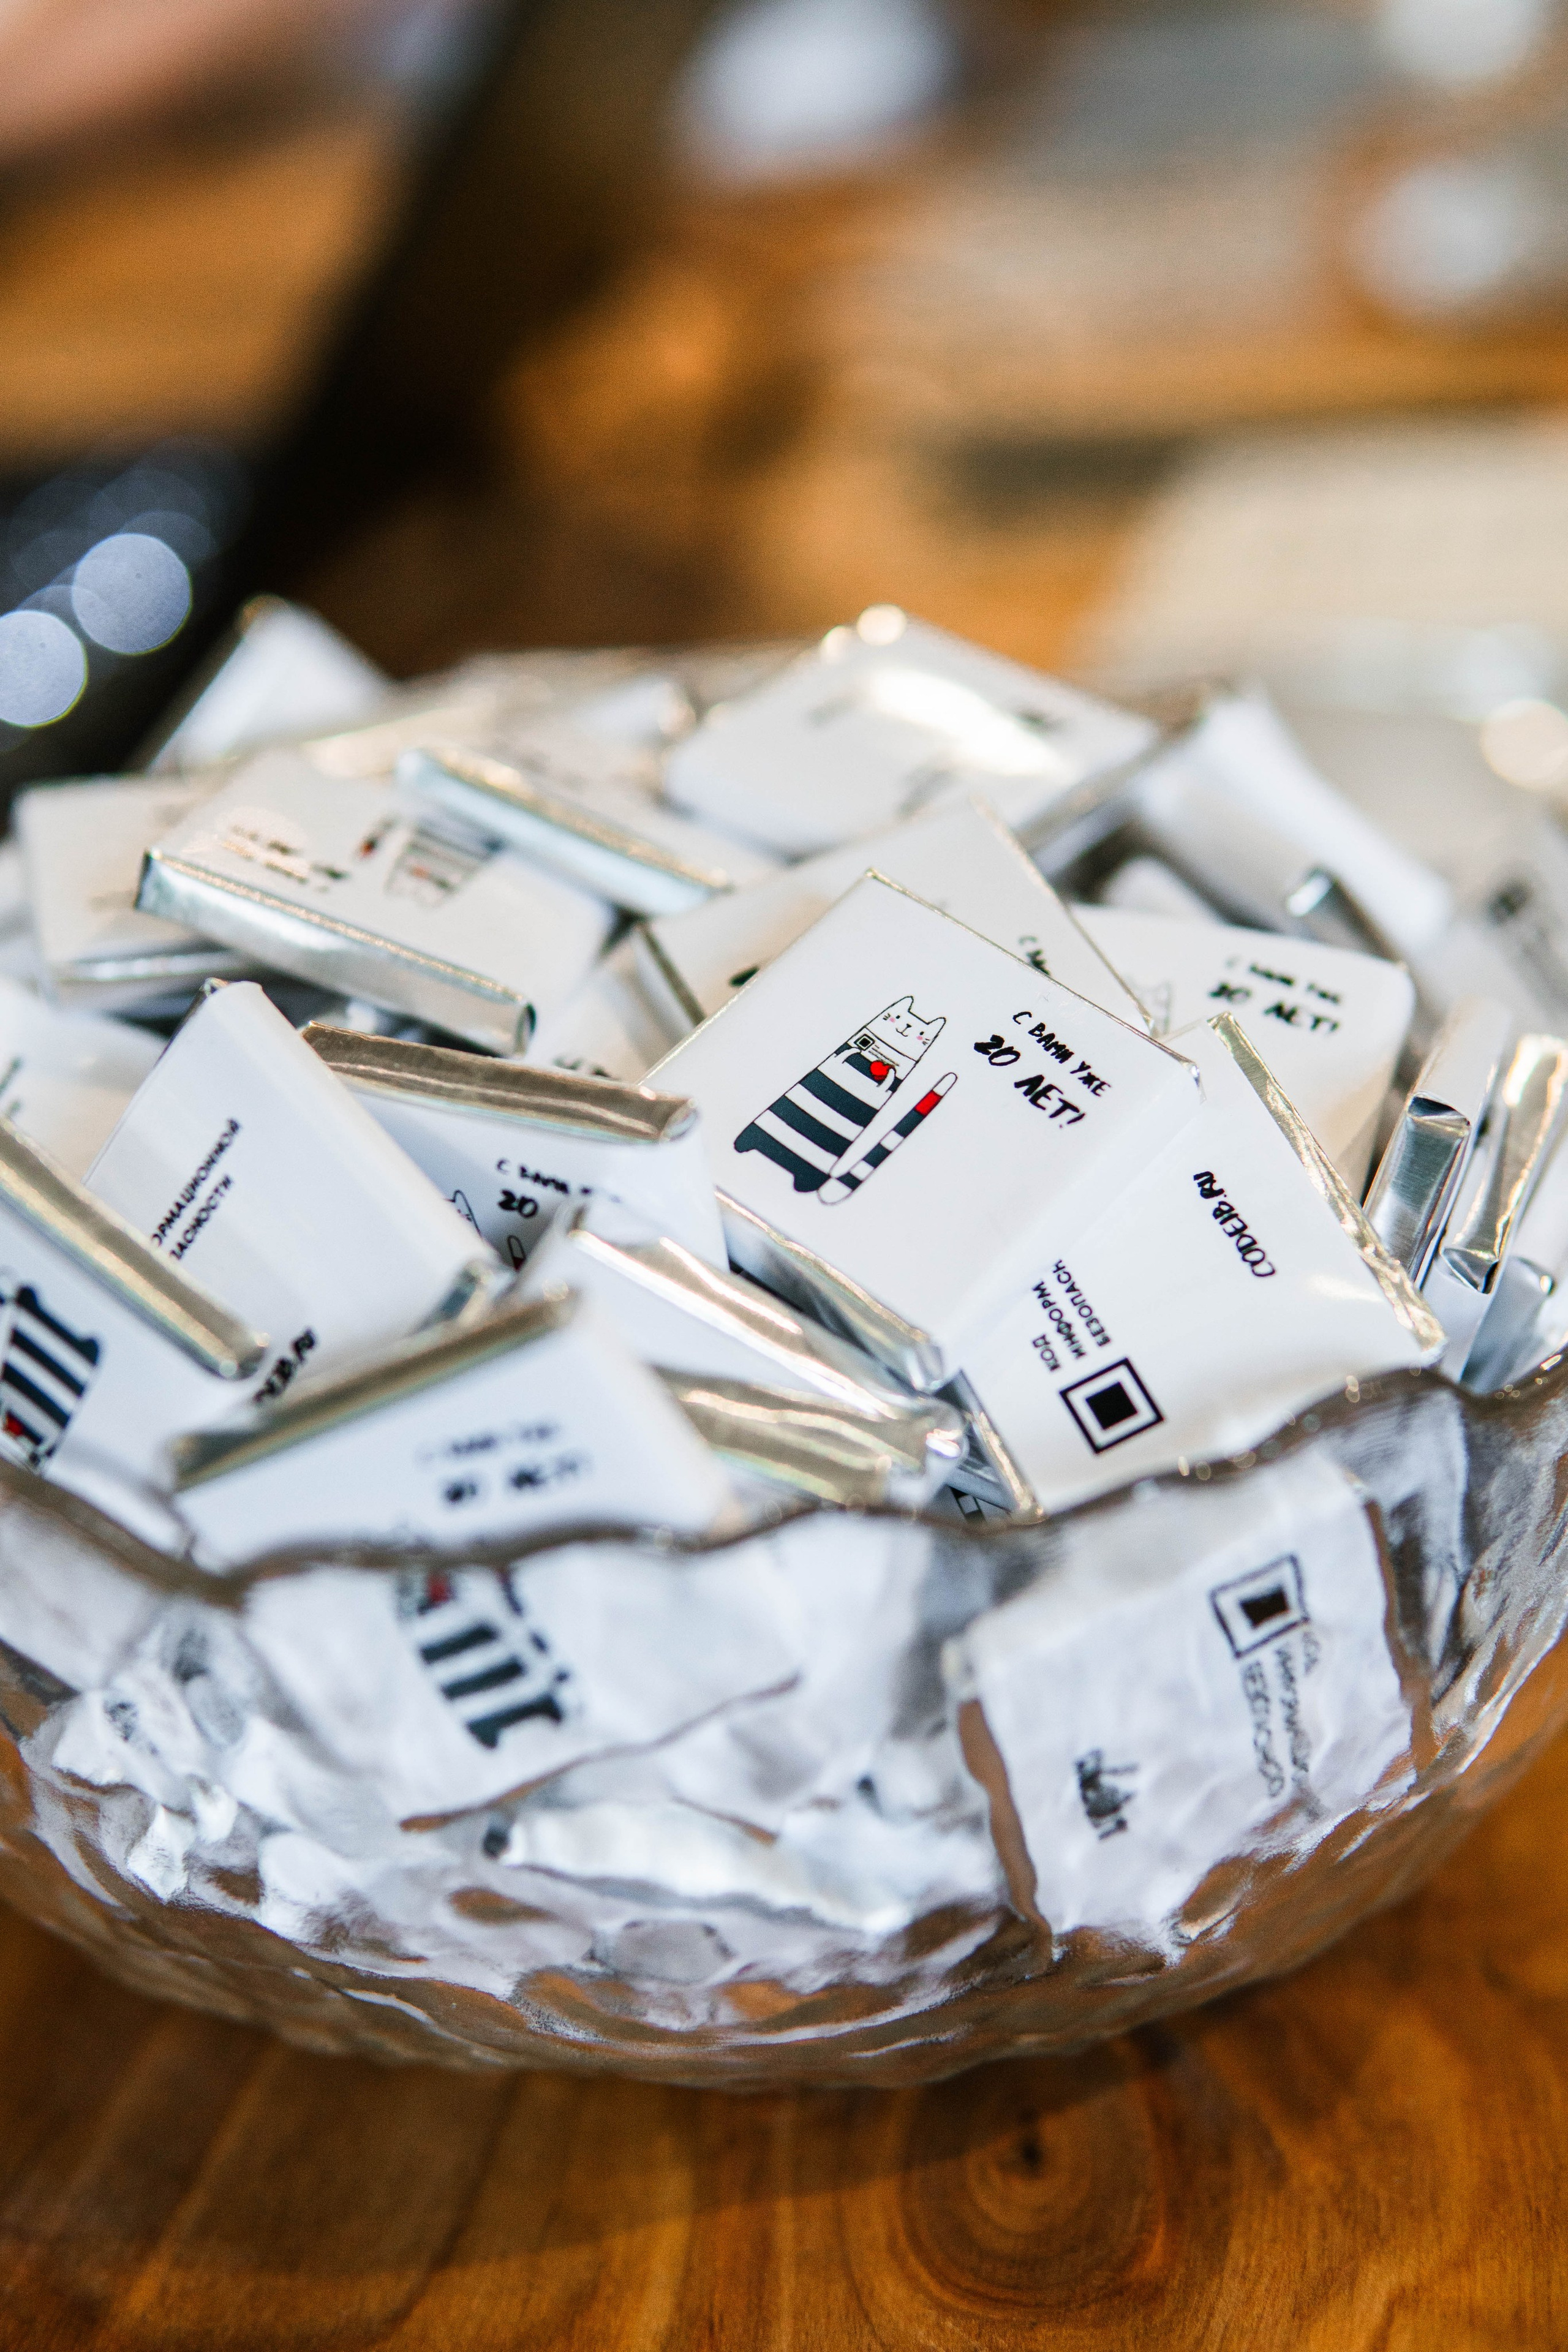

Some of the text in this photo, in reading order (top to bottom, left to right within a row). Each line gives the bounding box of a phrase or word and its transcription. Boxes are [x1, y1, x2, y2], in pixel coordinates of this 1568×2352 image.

[974, 1034, 1086, 1129] 20 ЛЕТ!
[1012, 1011, 1112, 1097] С ВАМИ УЖЕ
[497, 1189, 538, 1218] 20
[1193, 1171, 1276, 1277] CODEIB.RU
[1032, 1281, 1087, 1359] ИНФОРМ
[1032, 1333, 1060, 1372] КОД
